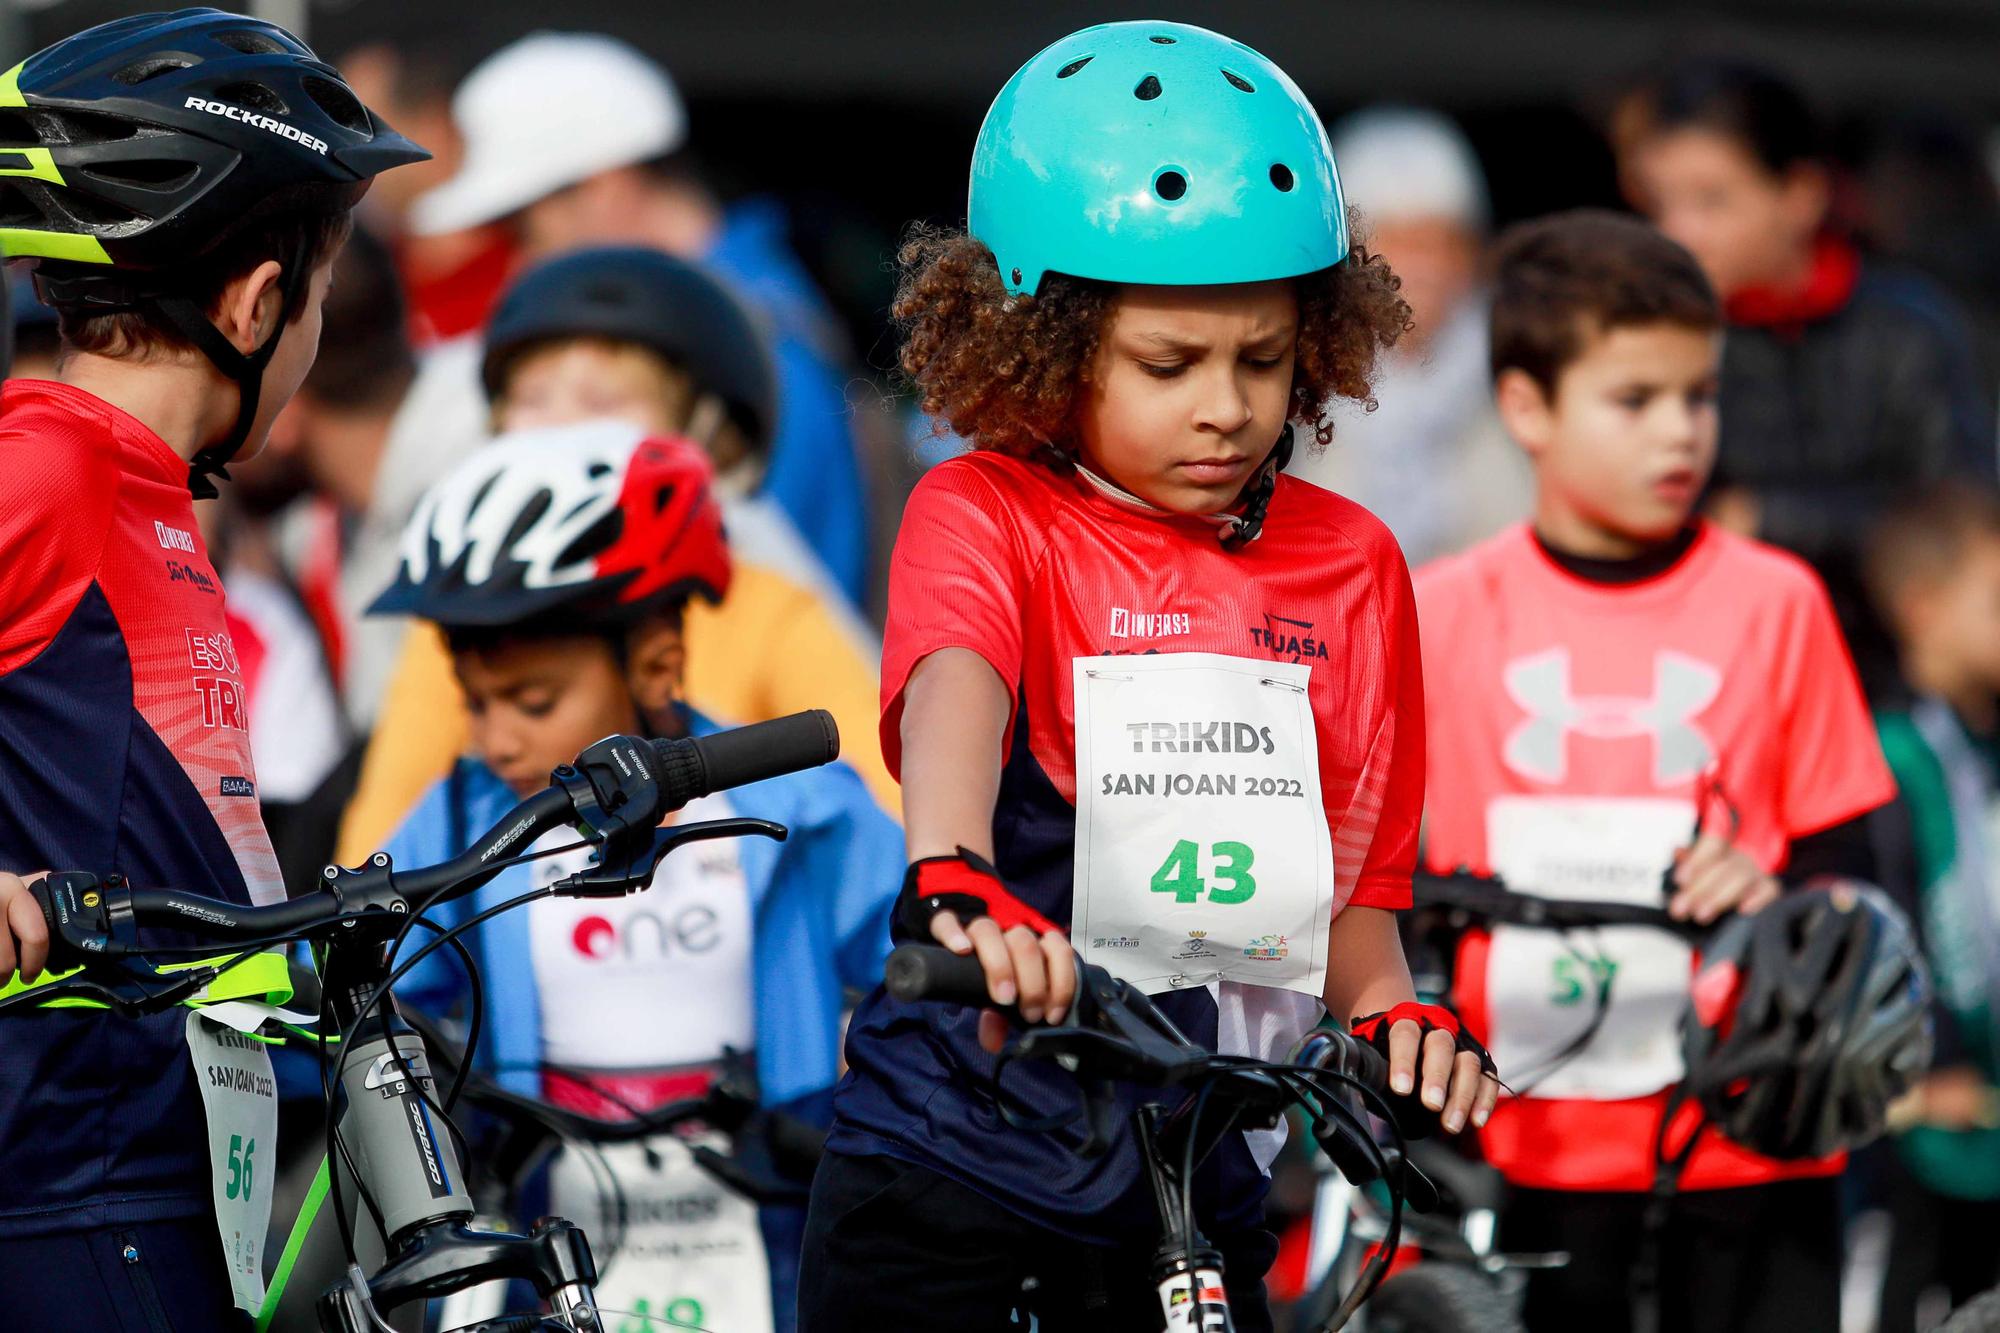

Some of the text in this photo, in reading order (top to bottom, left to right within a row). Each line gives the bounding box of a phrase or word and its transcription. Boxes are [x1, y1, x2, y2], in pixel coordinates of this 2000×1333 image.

[184, 97, 329, 156] ROCKRIDER
[1131, 612, 1190, 637] INVERSE
[1126, 721, 1275, 755] TRIKIDS
[1101, 773, 1304, 798] SAN JOAN 2022
[1150, 839, 1256, 904] 43
[208, 1065, 273, 1098] SAN JOAN 2022
[409, 1101, 442, 1186] corratec
[226, 1134, 255, 1202] 56
